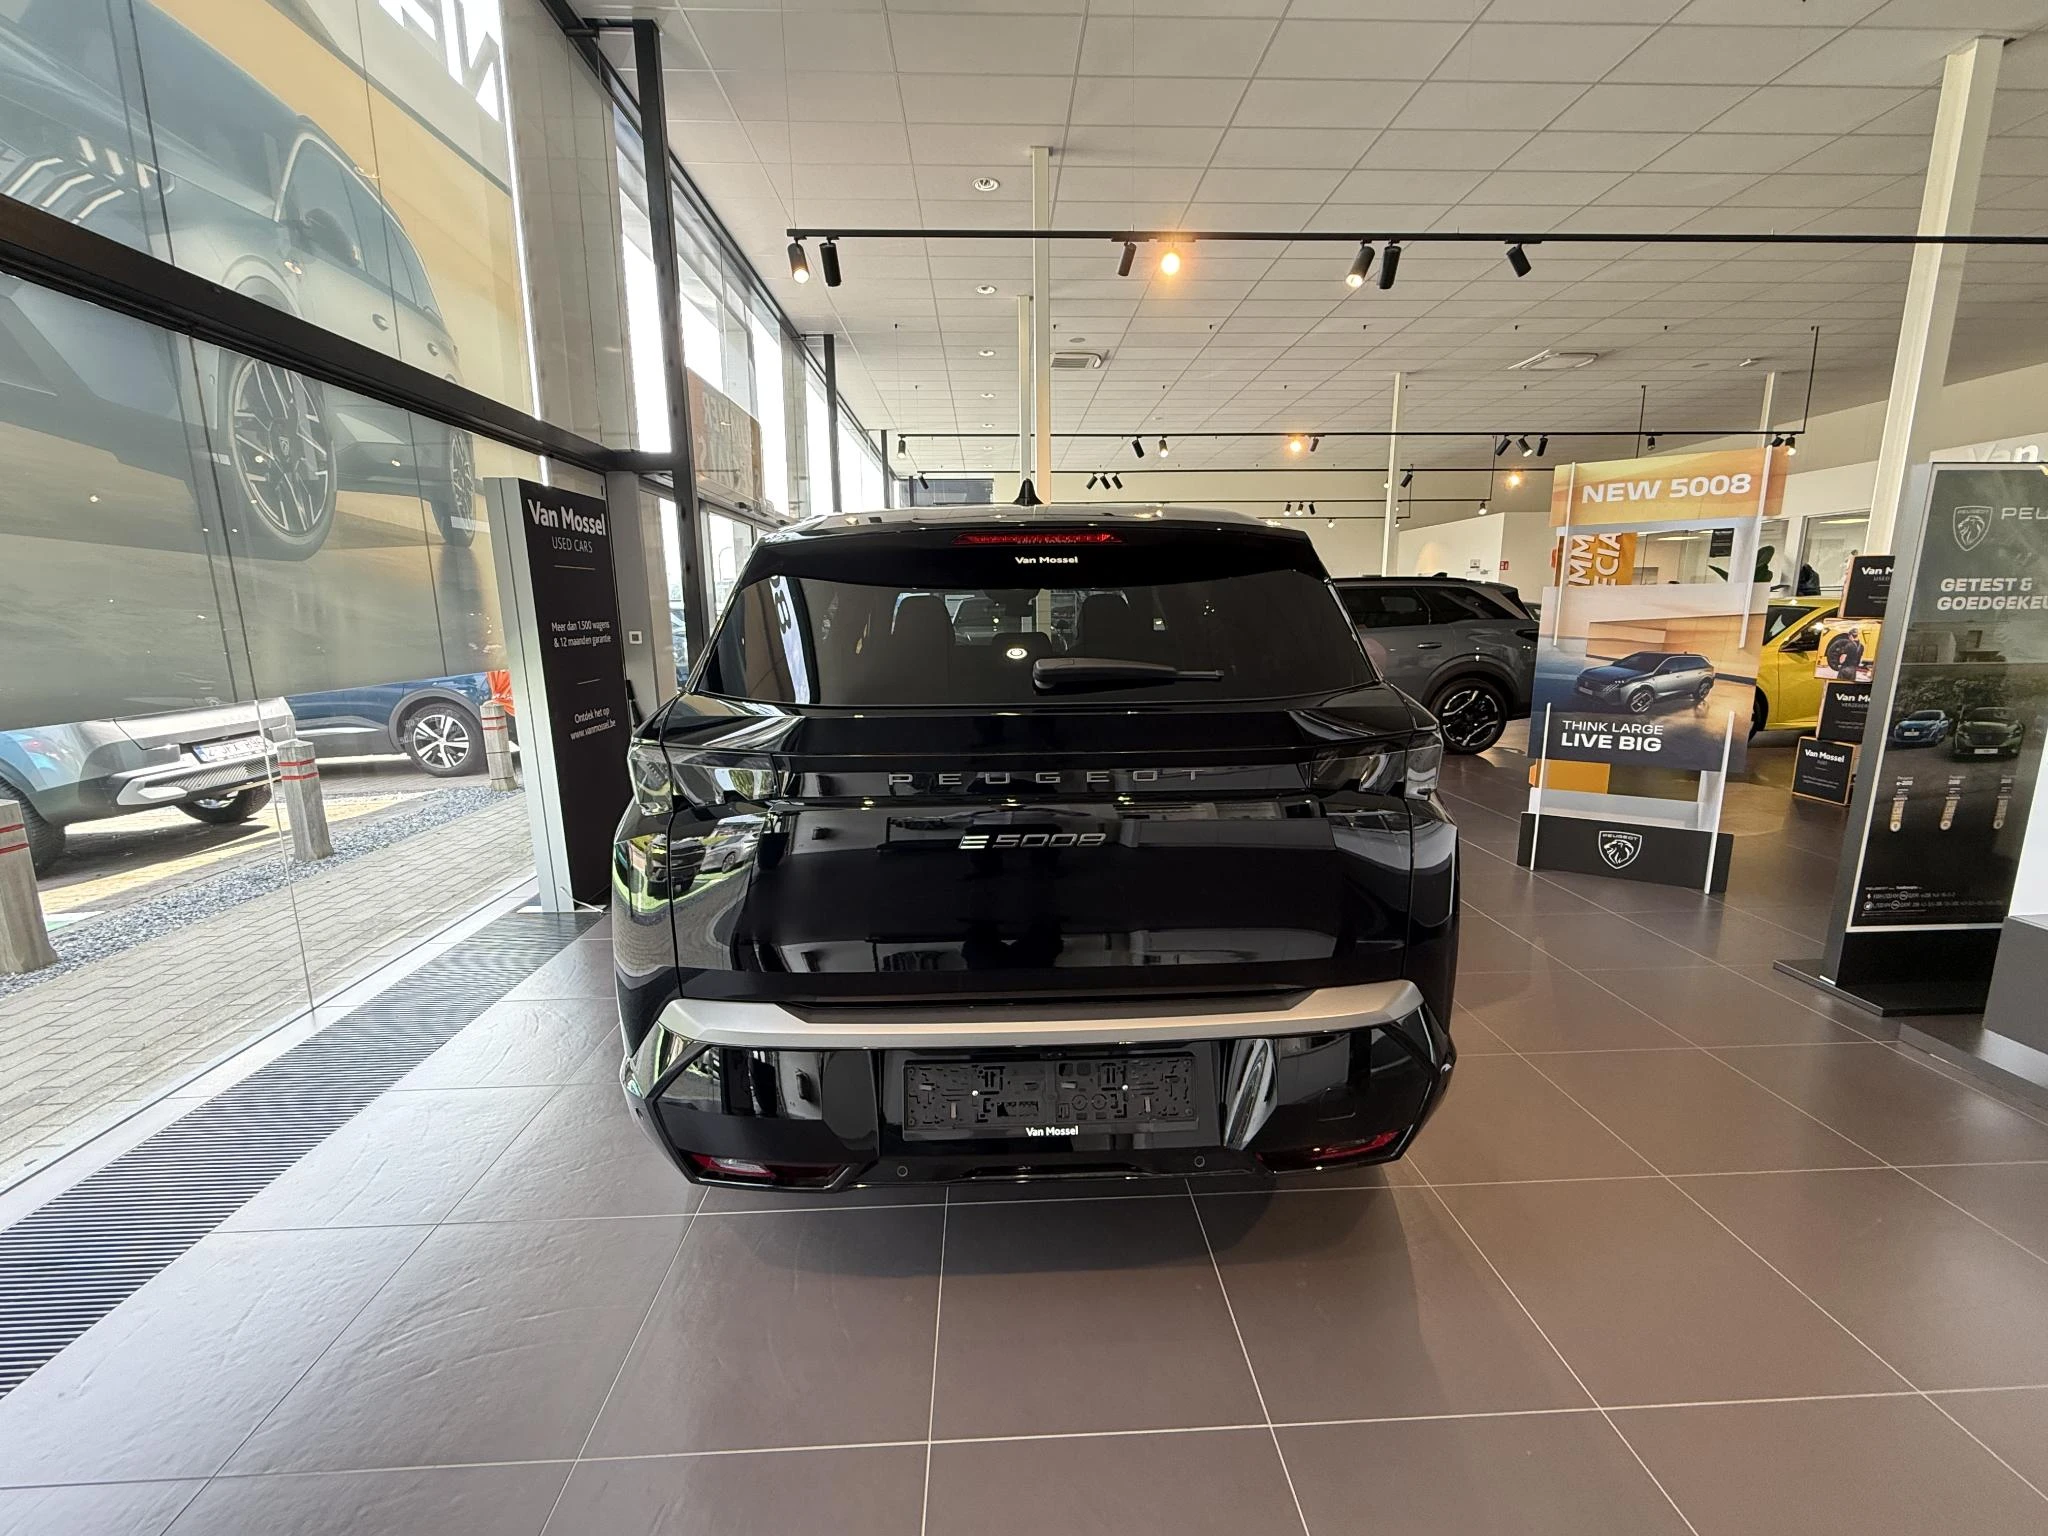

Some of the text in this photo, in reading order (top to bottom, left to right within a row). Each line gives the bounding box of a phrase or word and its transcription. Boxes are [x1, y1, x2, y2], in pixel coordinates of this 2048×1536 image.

[1581, 472, 1752, 504] NEW 5008
[527, 498, 607, 536] Van Mossel
[551, 536, 593, 553] USED CARS
[1015, 556, 1079, 564] Van Mossel
[1861, 566, 1883, 575] Van
[1940, 577, 2033, 592] GETEST &
[551, 622, 566, 632] Meer
[567, 621, 577, 631] dan
[560, 636, 568, 647] 12
[1835, 692, 1856, 702] Van
[574, 710, 594, 723] Ontdek
[1562, 720, 1664, 735] THINK LARGE
[1561, 732, 1662, 752] LIVE BIG
[1804, 748, 1819, 758] Van
[1819, 751, 1845, 763] Mossel
[888, 769, 1205, 786] PEUGEOT
[1025, 1125, 1079, 1137] Van Mossel
